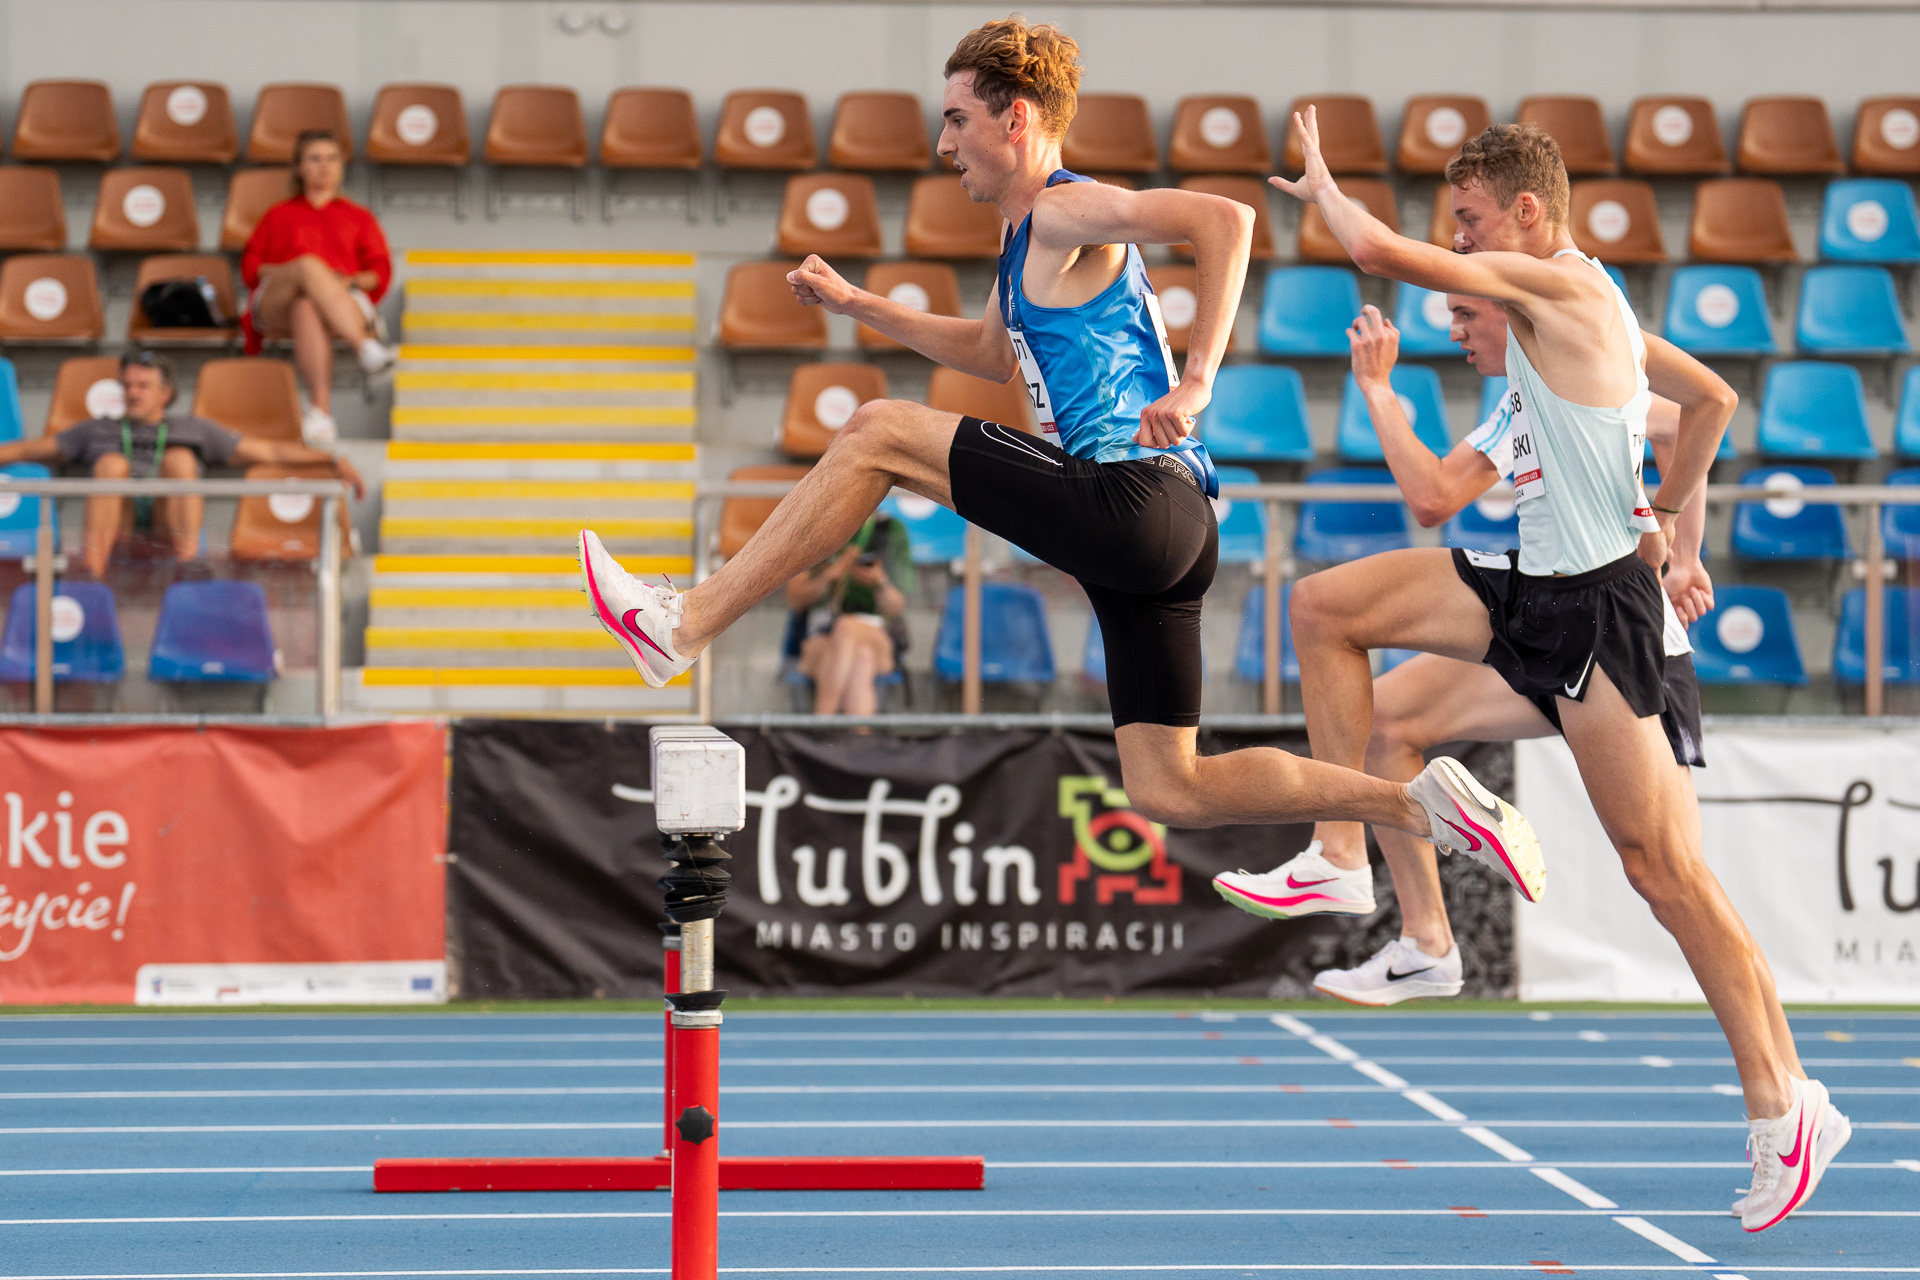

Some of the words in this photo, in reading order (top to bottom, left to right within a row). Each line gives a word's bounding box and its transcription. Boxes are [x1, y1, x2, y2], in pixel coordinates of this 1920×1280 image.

[0, 790, 130, 870] kie
[757, 922, 917, 951] MIASTO
[942, 921, 1185, 955] INSPIRACJI
